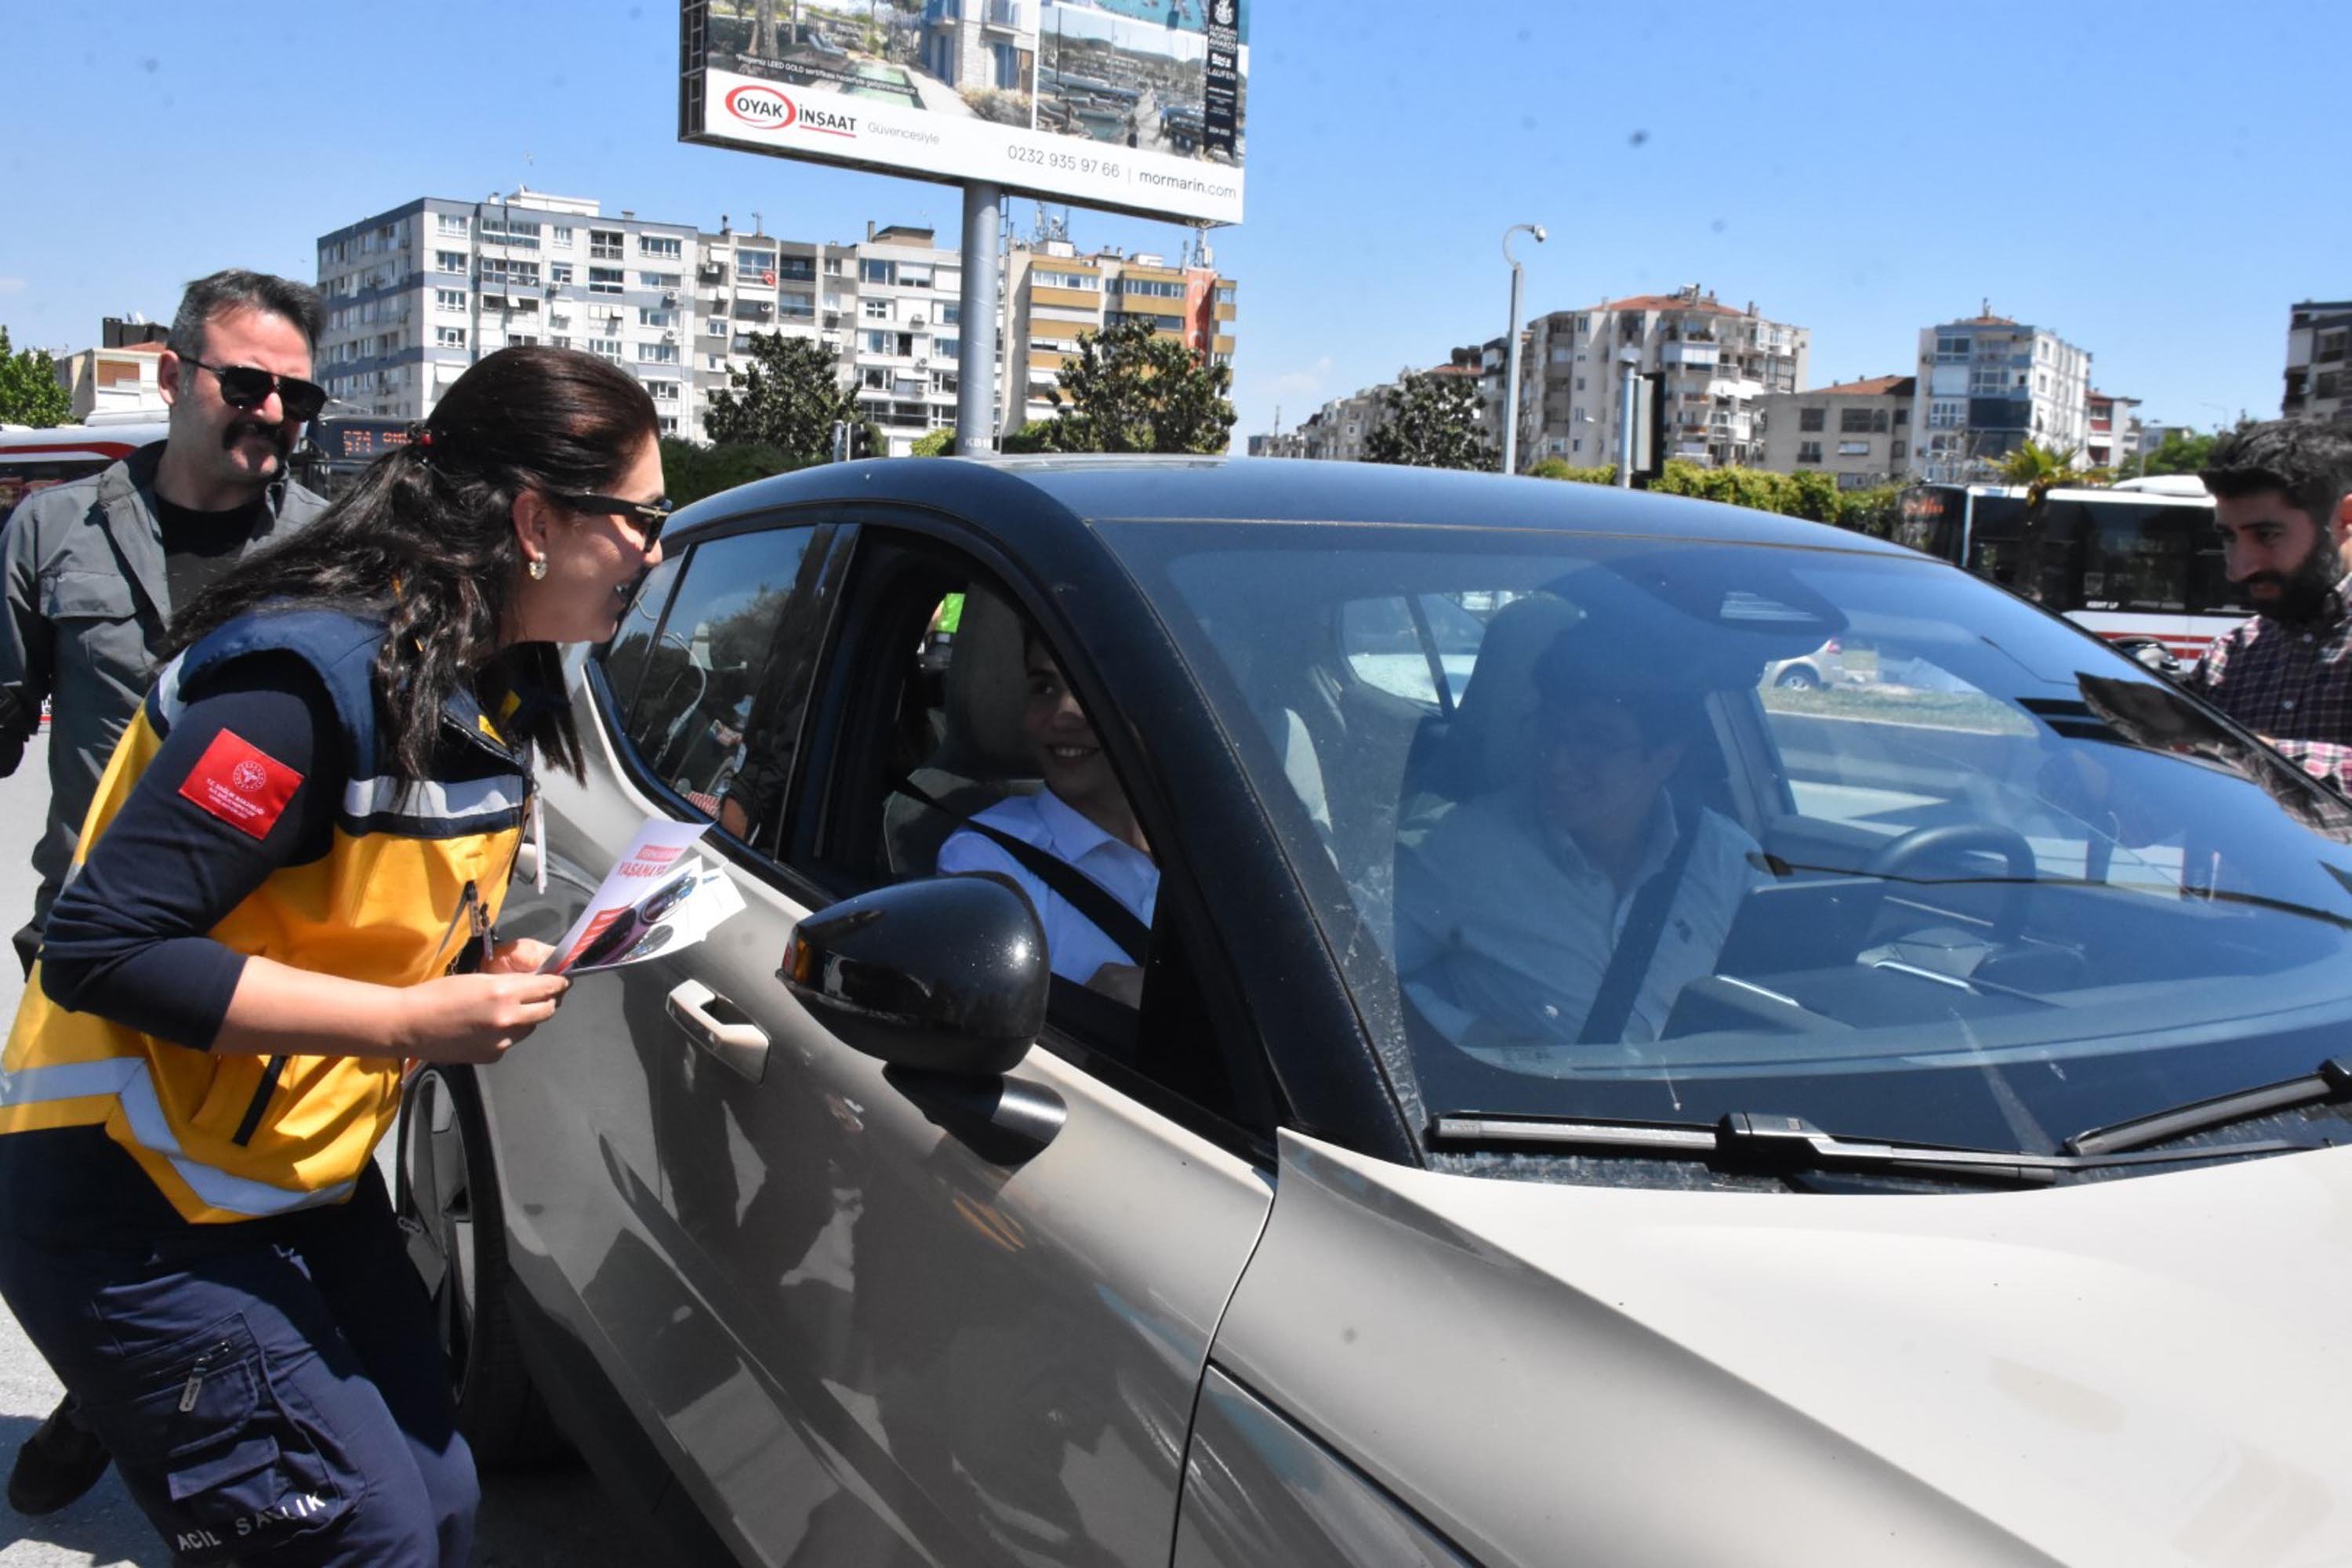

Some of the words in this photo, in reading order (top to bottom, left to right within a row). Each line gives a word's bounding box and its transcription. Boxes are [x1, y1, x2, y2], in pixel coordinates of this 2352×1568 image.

[767, 60, 784, 70] LEED
[785, 63, 804, 74] GOLD
[737, 97, 782, 118] OYAK
[799, 104, 857, 131] İNŞAAT
[867, 122, 939, 144] Güvencesiyle
[1008, 145, 1044, 165] 0232
[1049, 153, 1076, 171] 935
[1080, 158, 1098, 173] 97
[1102, 162, 1120, 178] 66
[1139, 170, 1236, 198] mormarin.com
